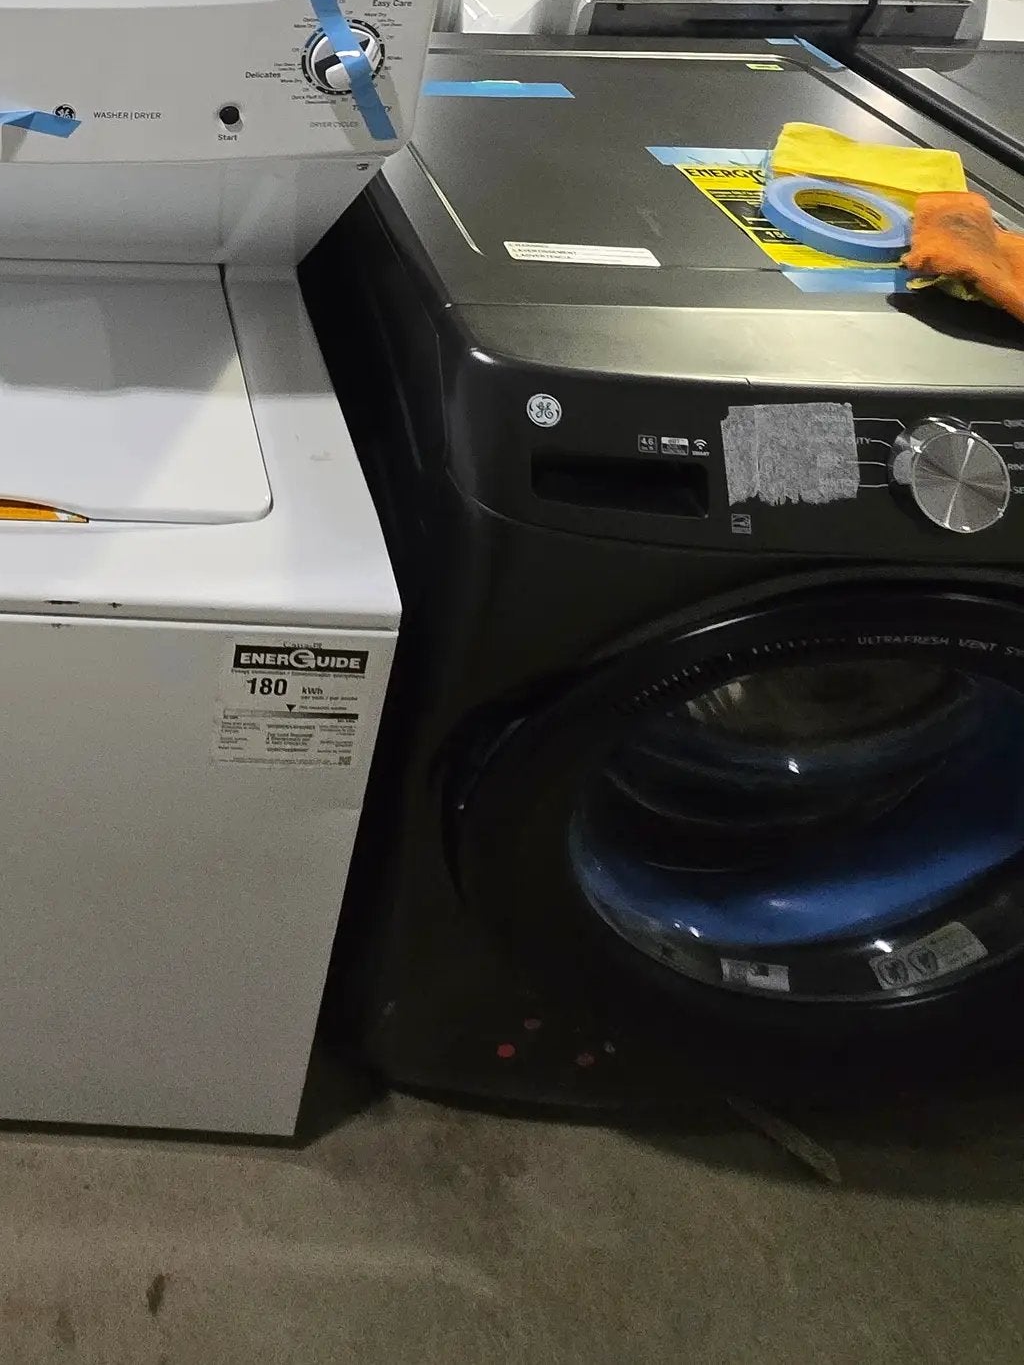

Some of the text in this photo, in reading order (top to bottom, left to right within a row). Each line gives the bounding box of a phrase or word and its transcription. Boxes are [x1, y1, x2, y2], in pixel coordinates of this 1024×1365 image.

[372, 0, 413, 8] Easy Care
[93, 111, 129, 119] WASHER
[134, 112, 162, 120] DRYER
[857, 635, 949, 646] ULTRAFRESH
[958, 638, 998, 651] VENT
[240, 649, 362, 669] ENERGUIDE
[246, 678, 288, 696] 180
[301, 686, 323, 695] kWh
